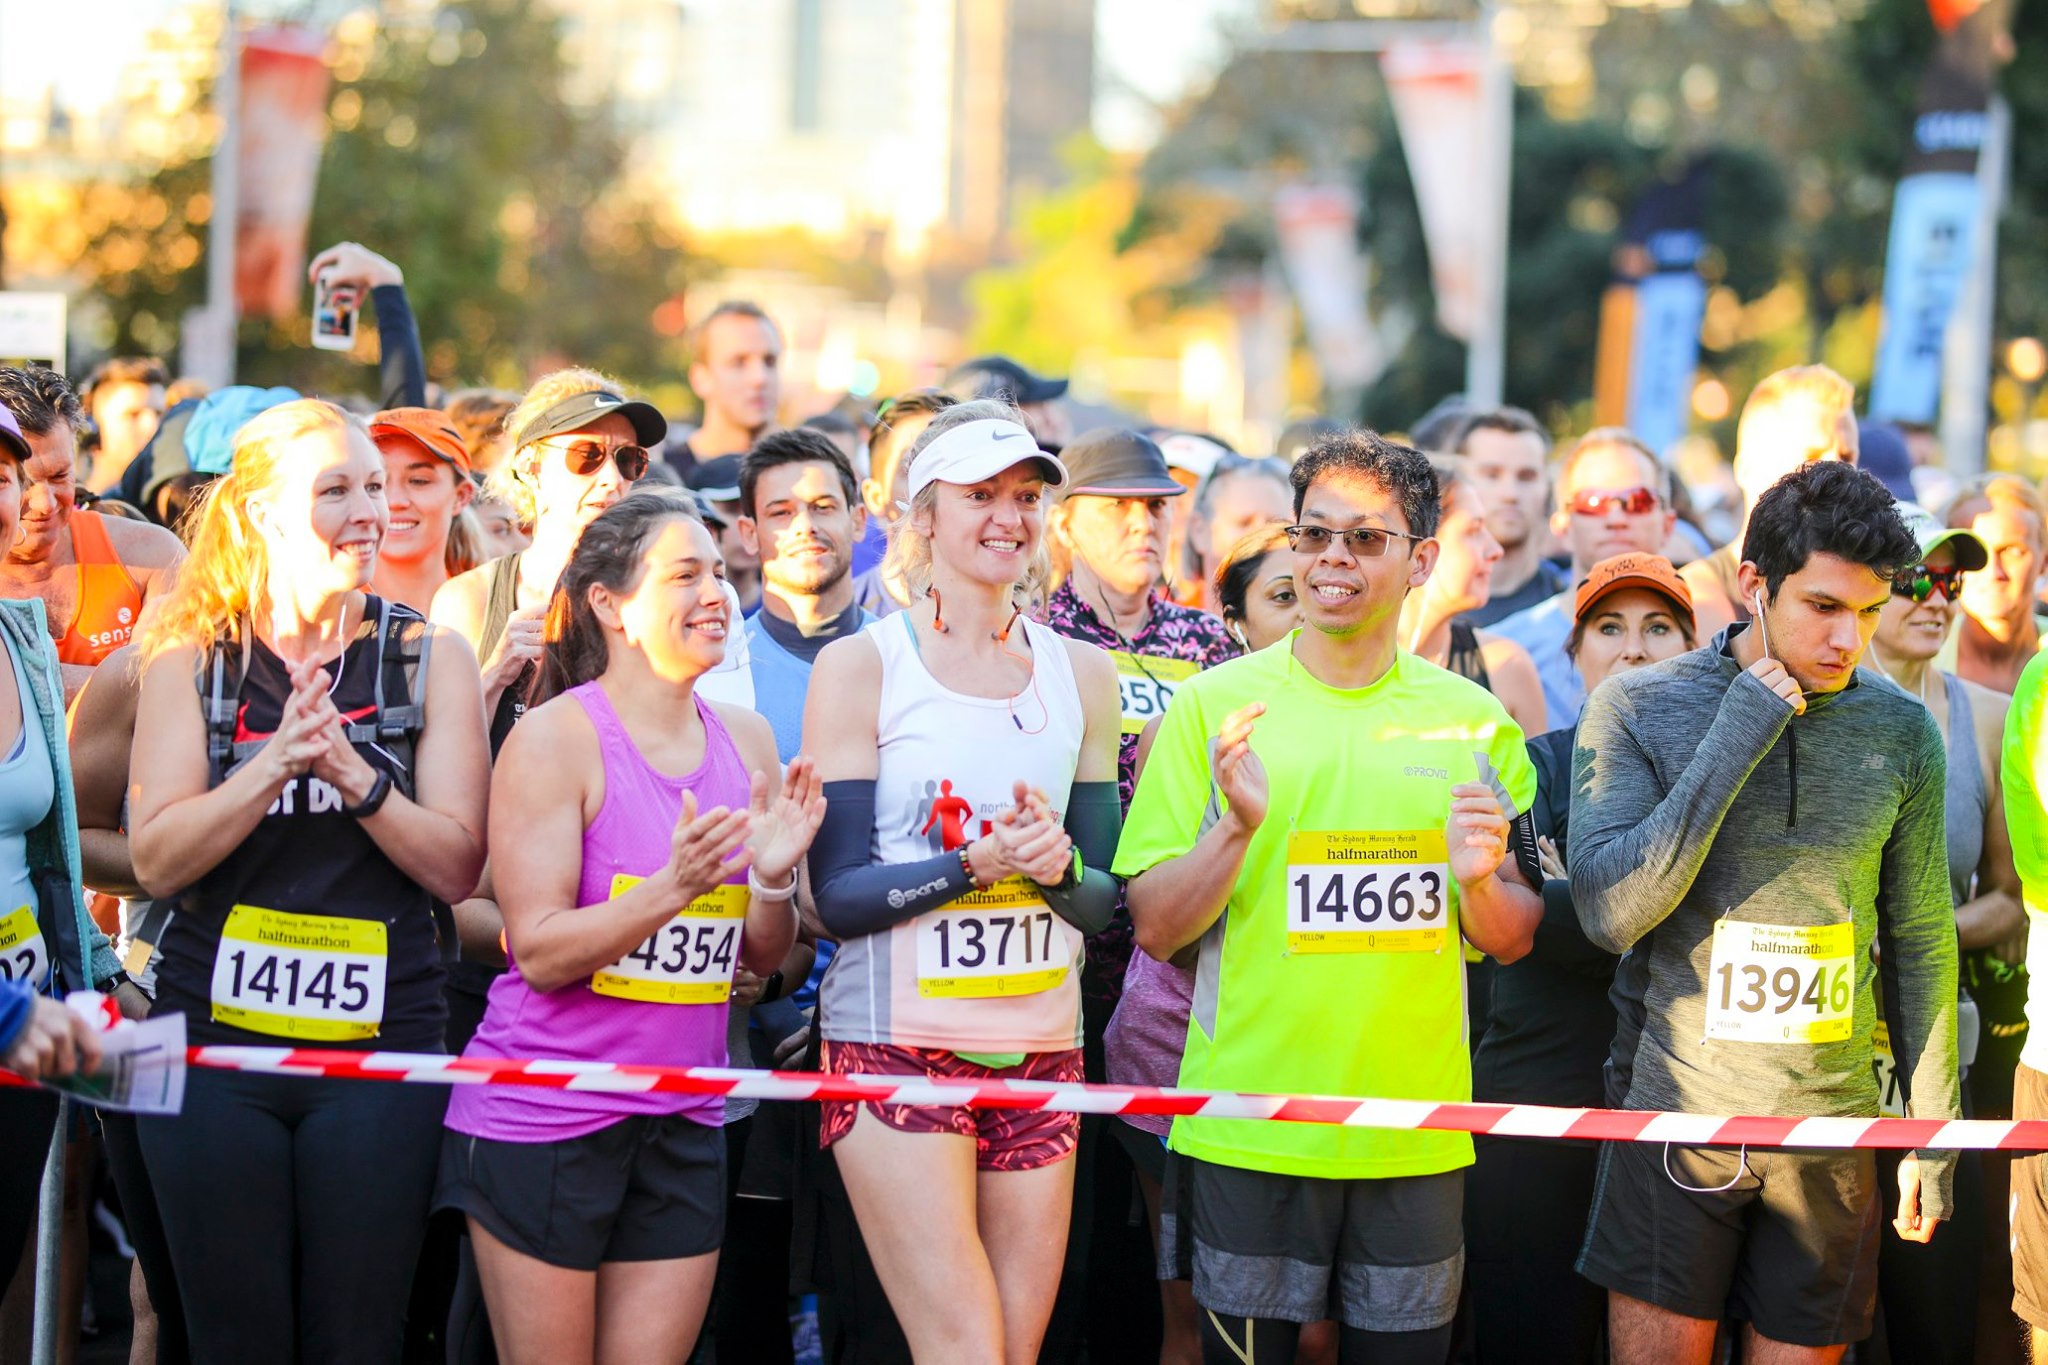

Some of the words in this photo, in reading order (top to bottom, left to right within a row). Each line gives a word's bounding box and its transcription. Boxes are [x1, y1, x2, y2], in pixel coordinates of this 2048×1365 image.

[1327, 848, 1418, 860] halfmarathon
[1294, 871, 1441, 922] 14663
[258, 928, 350, 948] halfmarathon
[611, 925, 736, 975] 4354
[934, 912, 1053, 968] 13717
[1300, 933, 1325, 941] YELLOW
[1751, 940, 1834, 955] halfmarathon
[231, 950, 369, 1012] 14145
[1717, 962, 1849, 1015] 13946
